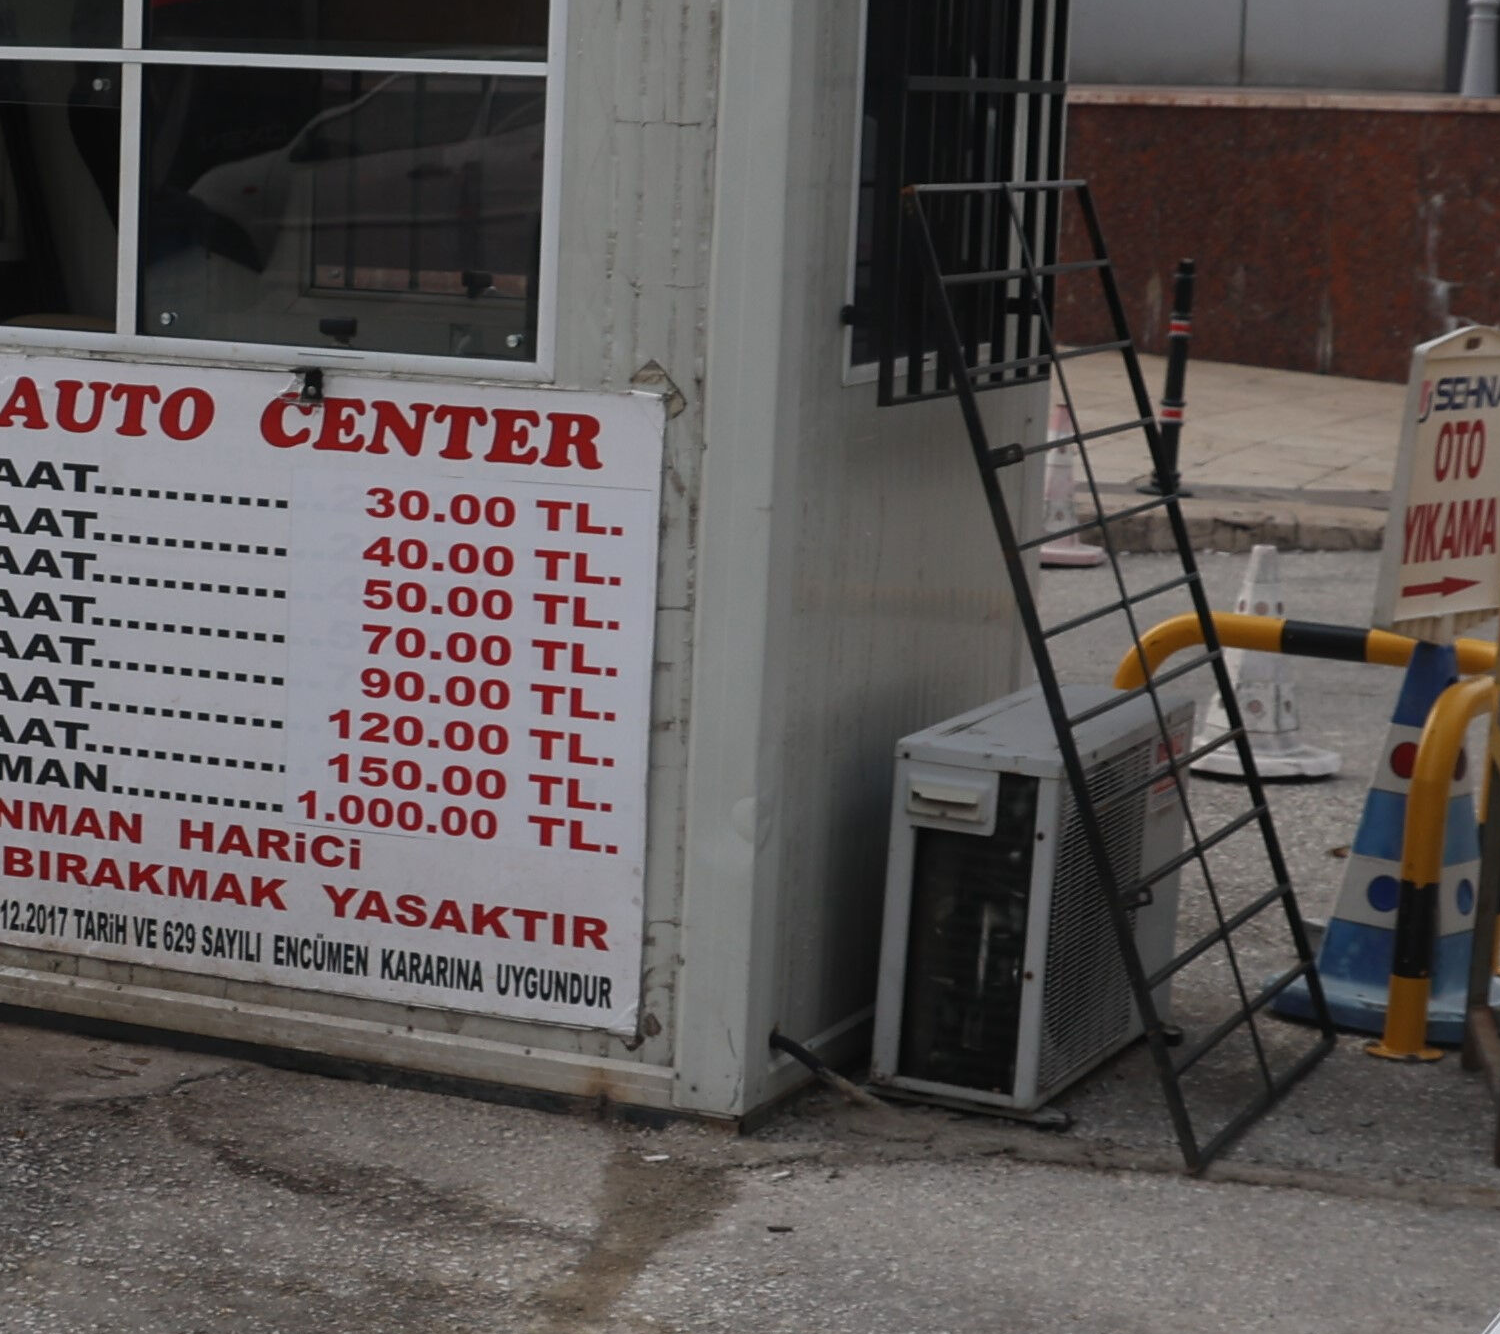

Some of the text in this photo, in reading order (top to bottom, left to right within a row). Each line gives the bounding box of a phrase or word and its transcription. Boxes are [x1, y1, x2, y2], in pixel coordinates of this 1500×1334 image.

[260, 391, 603, 471] CENTER
[1435, 419, 1485, 482] OTO
[365, 487, 517, 528] 30.00
[535, 499, 625, 537] TL.
[1402, 496, 1497, 565] YIKAMA
[362, 536, 515, 578] 40.00
[534, 548, 623, 587] TL.
[362, 579, 513, 622] 50.00
[532, 593, 621, 631] TL.
[360, 624, 512, 667] 70.00
[531, 639, 619, 678] TL.
[359, 667, 511, 711] 90.00
[529, 683, 616, 722] TL.
[327, 708, 510, 756] 120.00
[528, 729, 615, 768] TL.
[326, 752, 507, 800] 150.00
[528, 774, 614, 813] TL.
[297, 790, 498, 840] 1.000.00
[527, 815, 618, 855] TL.
[3, 845, 288, 911] BIRAKMAK
[322, 884, 610, 952] YASAKTIR
[134, 919, 158, 949] VE
[162, 921, 197, 954] 629
[201, 925, 262, 963] SAYILI
[273, 932, 369, 977] ENCÜMEN
[380, 948, 485, 993] KARARINA
[496, 962, 613, 1009] UYGUNDUR
